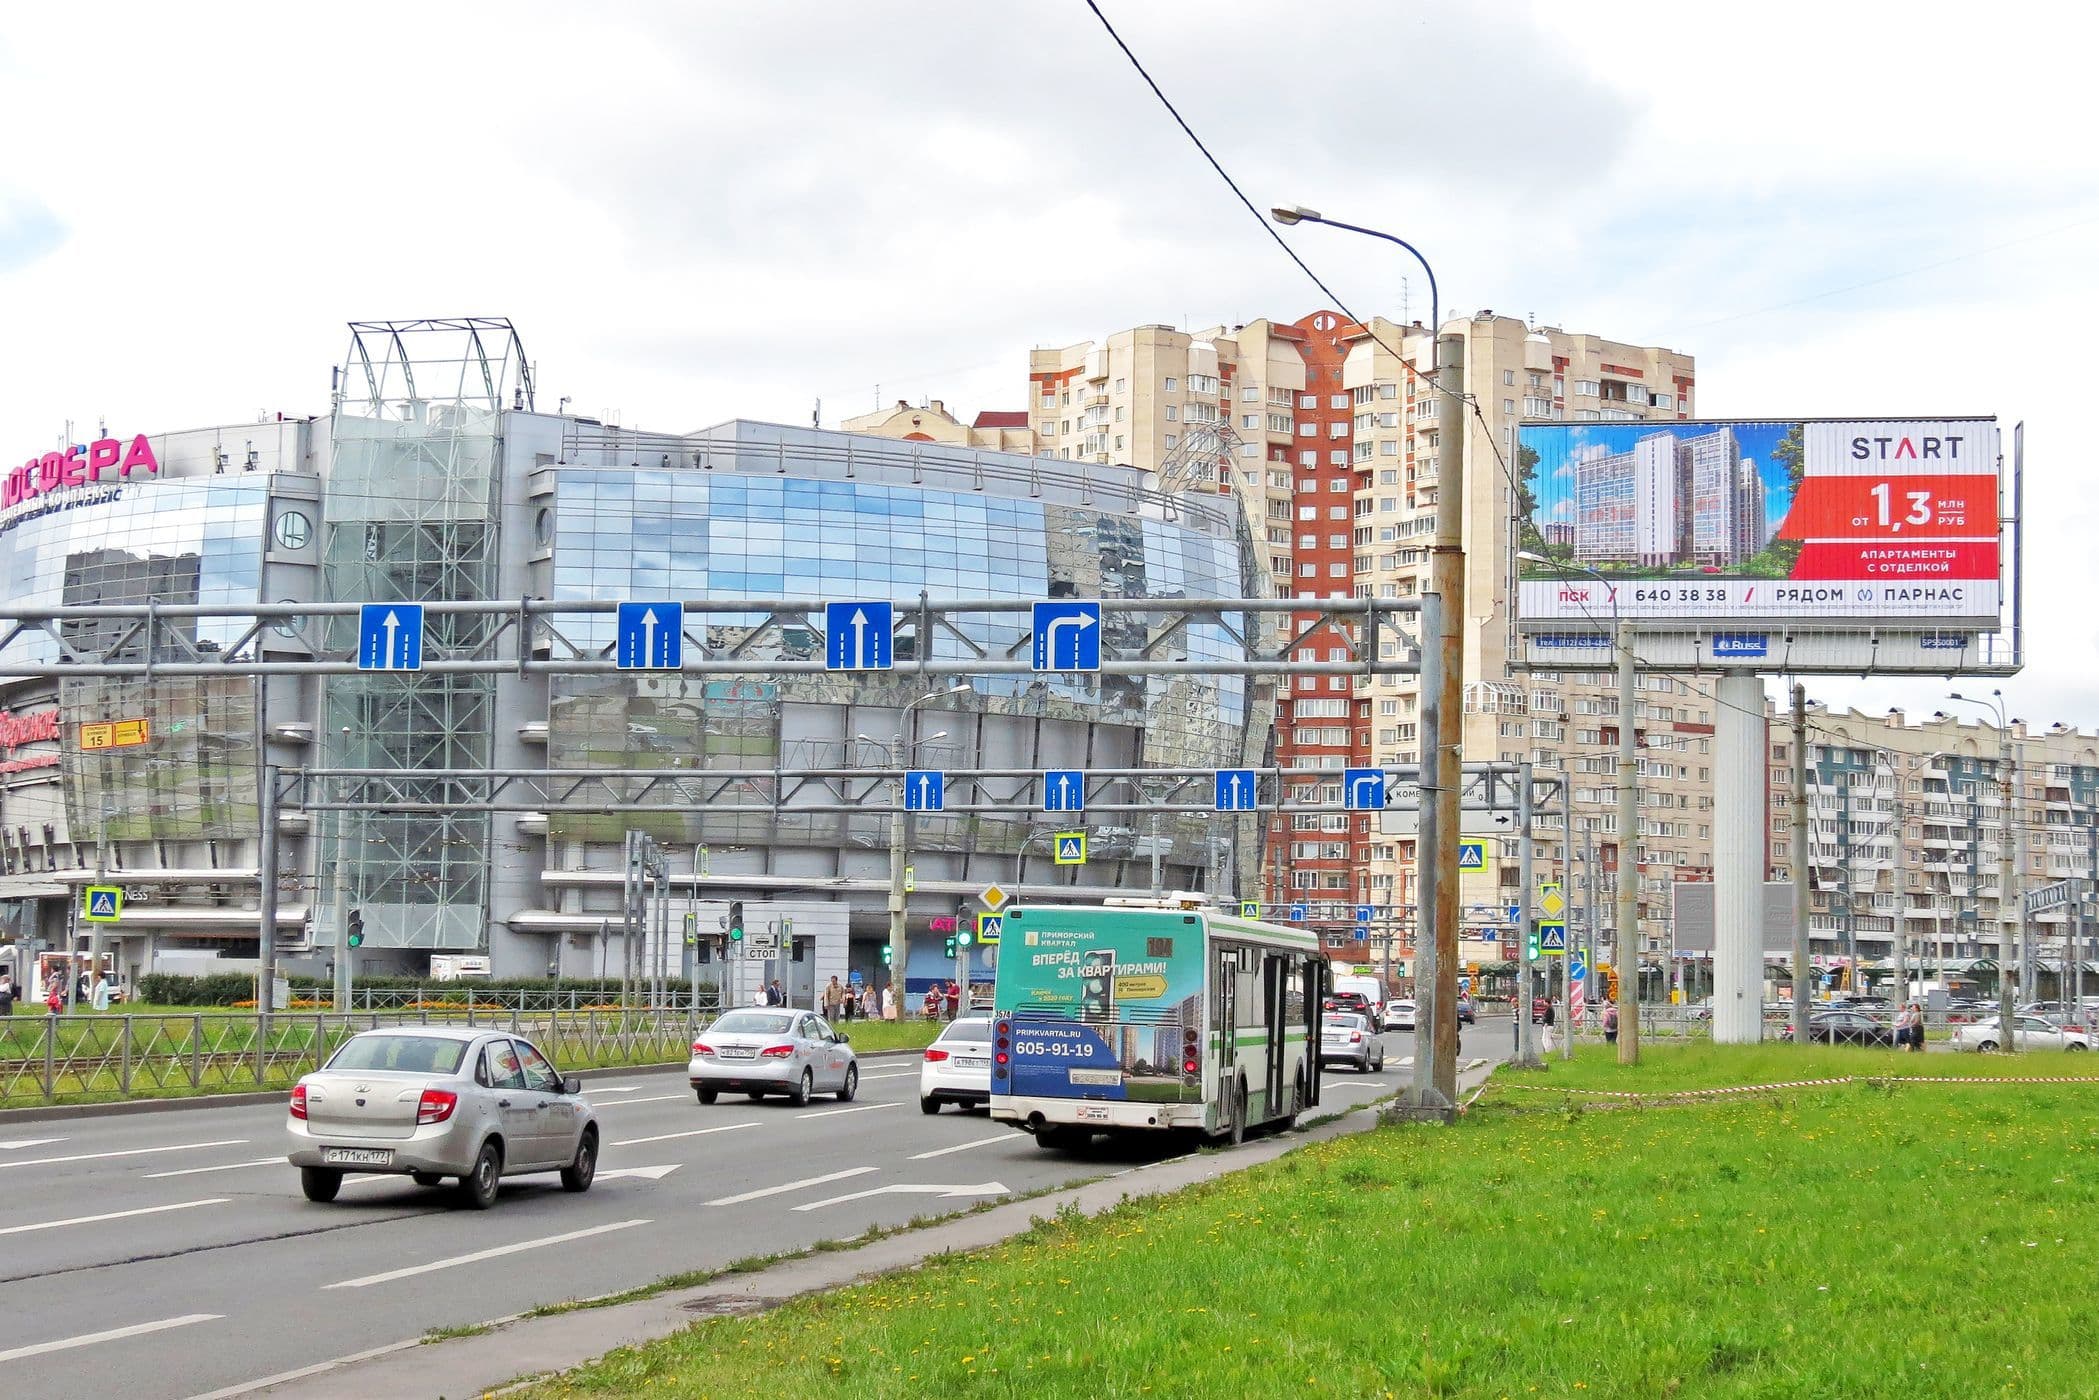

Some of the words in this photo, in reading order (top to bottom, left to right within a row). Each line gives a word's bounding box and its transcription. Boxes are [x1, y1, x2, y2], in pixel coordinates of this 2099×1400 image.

[1851, 517, 1869, 527] ОТ
[1870, 482, 1932, 532] 1,3
[1938, 500, 1965, 508] МЛН
[1938, 516, 1965, 526] РУБ
[1860, 550, 1956, 559] АПАРТАМЕНТЫ
[1867, 563, 1876, 573] С
[1880, 561, 1949, 573] ОТДЕЛКОЙ
[1559, 590, 1590, 602] ПСК
[1635, 589, 1671, 602] 640
[1678, 589, 1699, 602] 38
[1706, 589, 1727, 602] 38
[1776, 589, 1843, 603] РЯДОМ
[1885, 588, 1964, 601] ПАРНАС
[90, 736, 103, 746] 15
[1041, 931, 1095, 940] ПРИМОРСКИЙ
[750, 949, 776, 958] СТОП
[1032, 951, 1080, 966] ВПЕРЁД
[1057, 967, 1075, 979] ЗА
[1077, 962, 1167, 977] КВАРТИРАМИ!
[1016, 1029, 1081, 1038] PRIMKVARTAL.RU
[1015, 1041, 1093, 1057] 605-91-19
